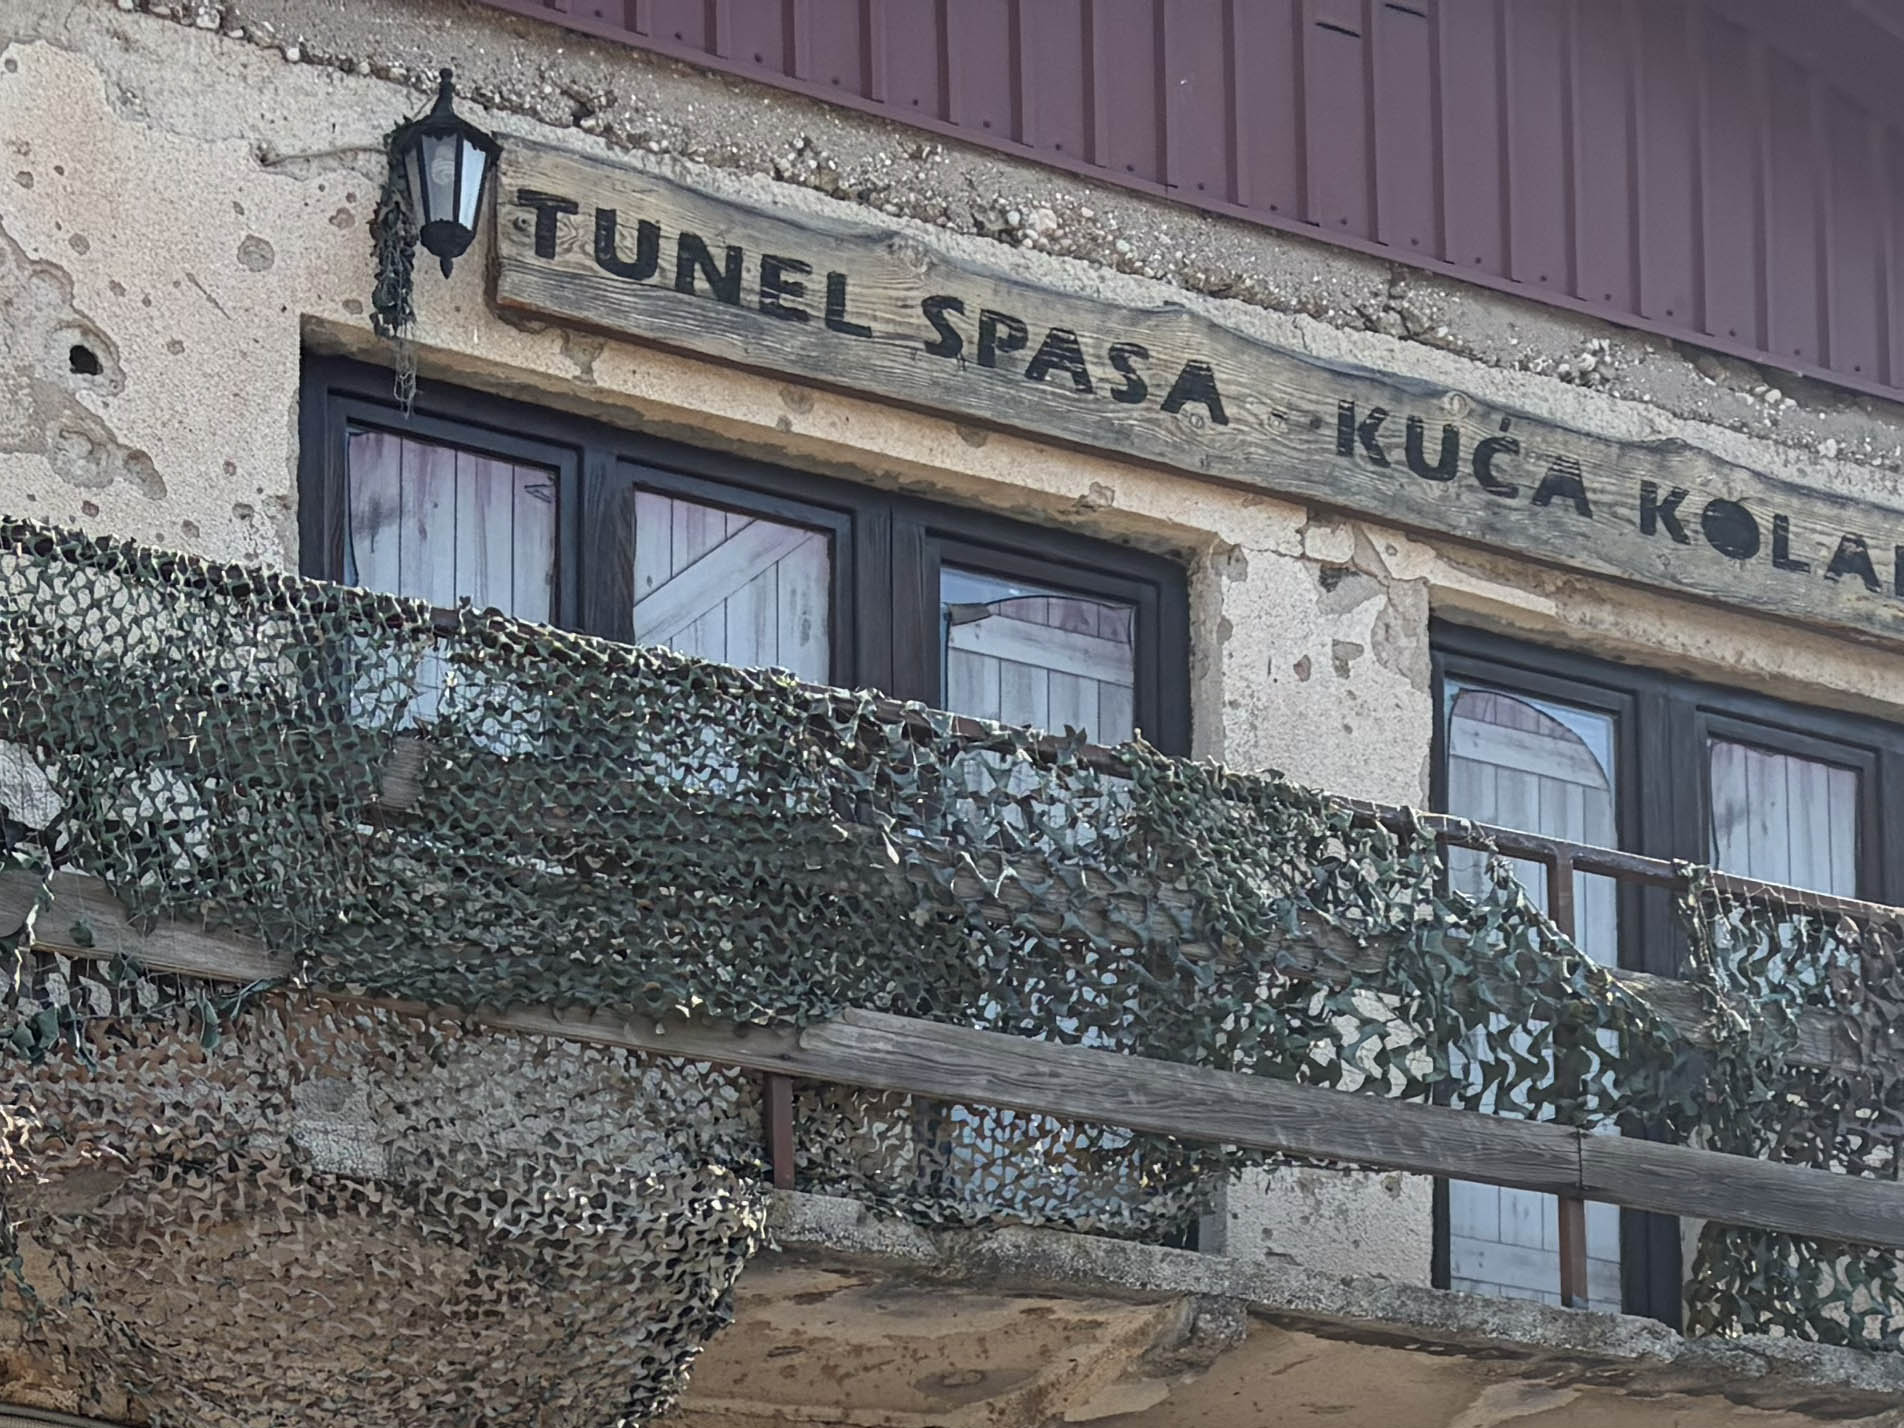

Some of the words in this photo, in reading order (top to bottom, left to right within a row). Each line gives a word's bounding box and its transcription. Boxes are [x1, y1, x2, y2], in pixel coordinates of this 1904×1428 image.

[517, 188, 872, 338] TUNEL
[921, 294, 1230, 426] SPASA
[1336, 399, 1594, 519] KUĆA
